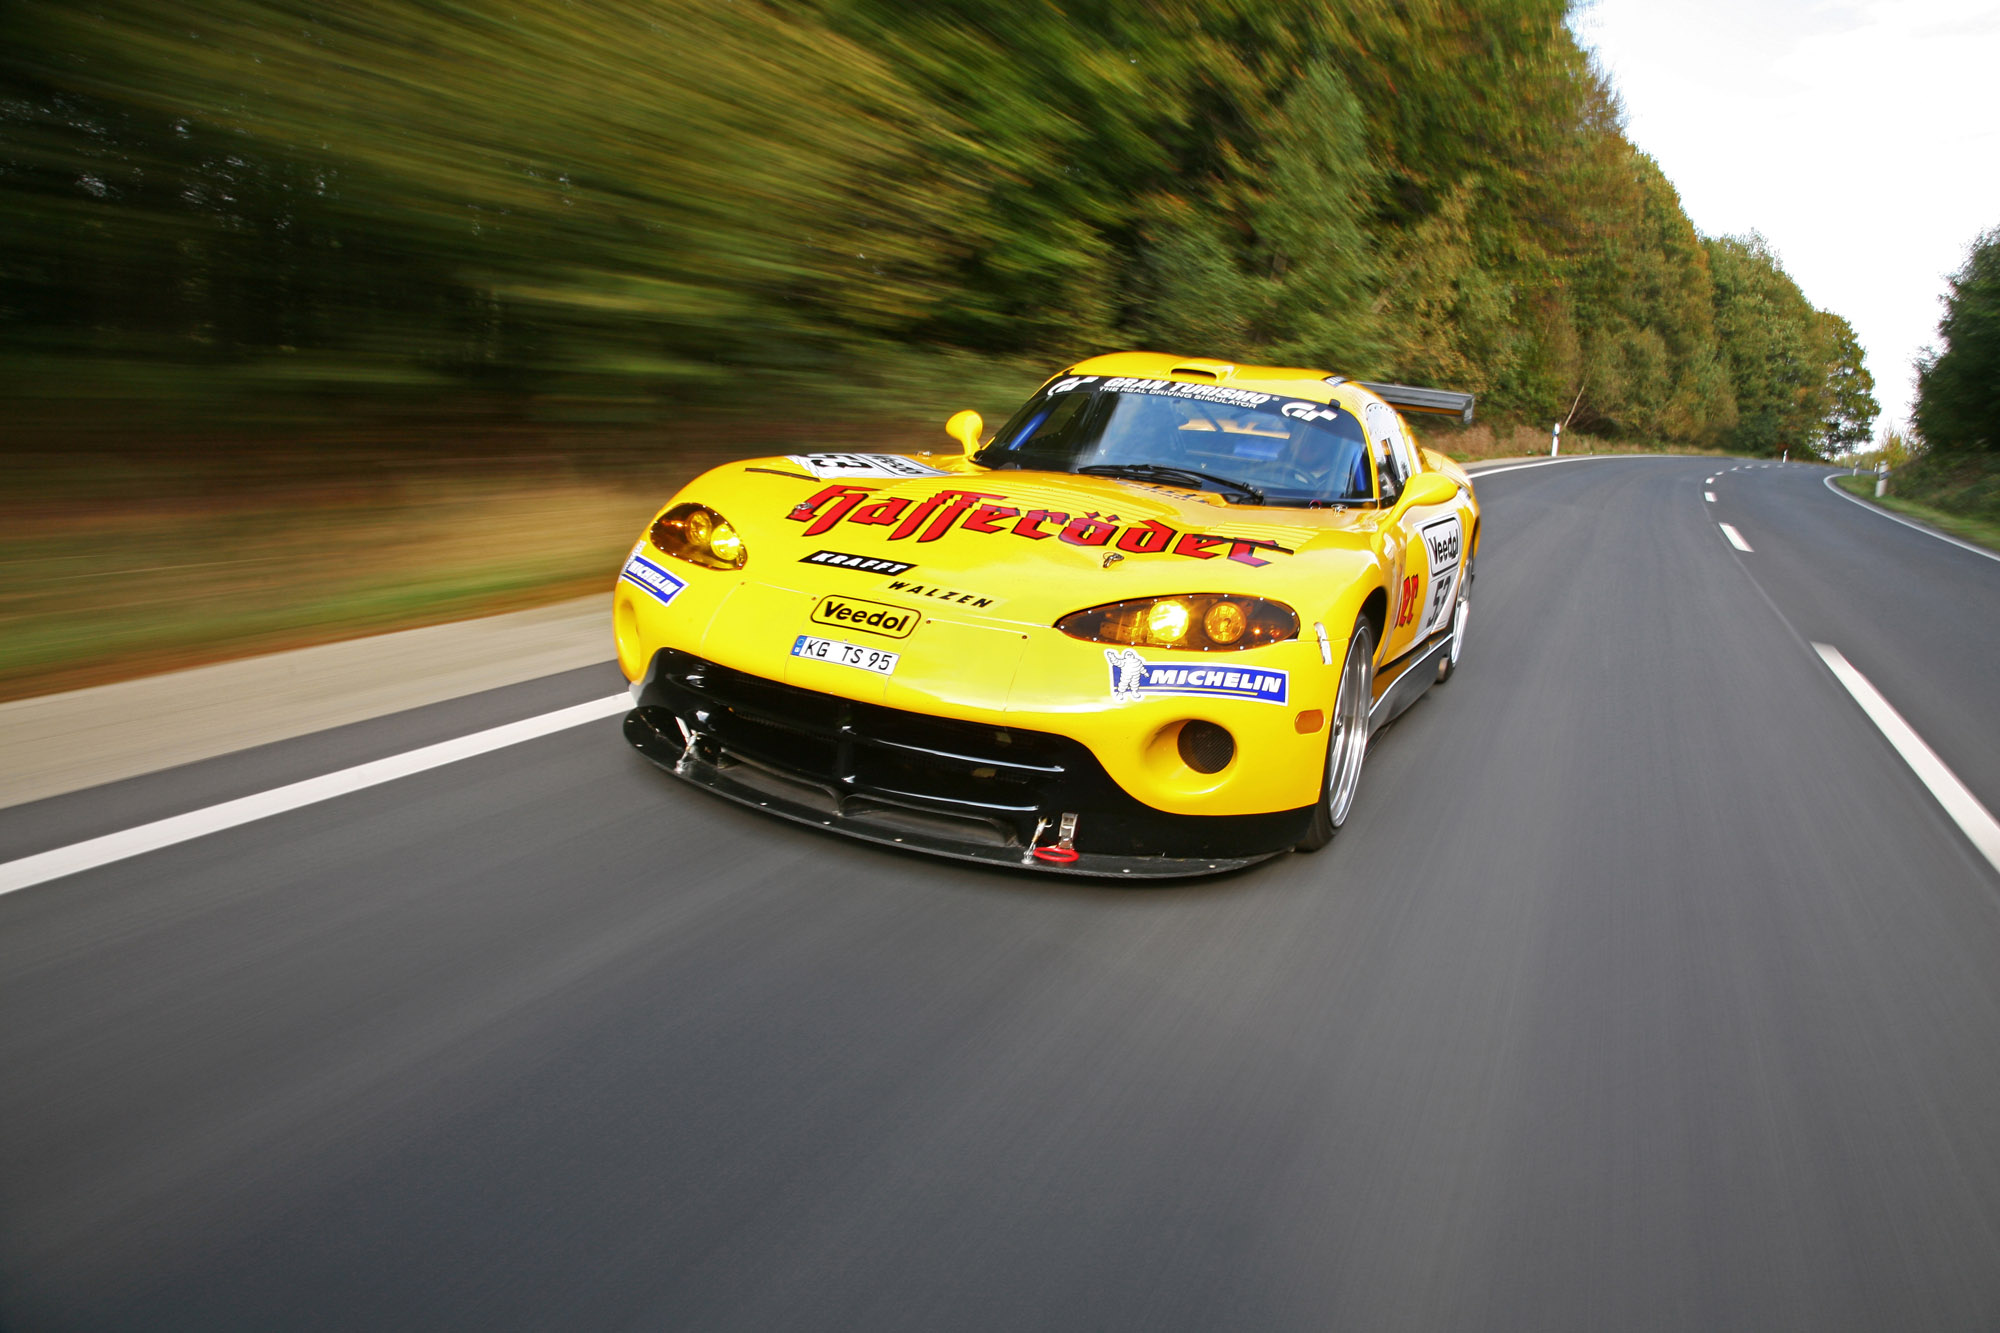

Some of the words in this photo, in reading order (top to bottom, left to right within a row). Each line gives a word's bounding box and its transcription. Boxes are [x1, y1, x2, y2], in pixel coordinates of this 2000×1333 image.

[1104, 377, 1171, 391] GRAN
[1170, 382, 1271, 405] TURISMO
[1148, 389, 1191, 399] DRIVING
[1194, 394, 1257, 409] SIMULATOR
[1428, 529, 1459, 565] Veedol
[811, 552, 909, 574] KRAFFT
[627, 560, 681, 596] MICHELIN
[888, 581, 994, 609] WALZEN
[823, 600, 910, 632] Veedol
[804, 639, 830, 658] KG
[842, 646, 863, 664] TS
[867, 652, 892, 671] 95
[1150, 669, 1282, 694] MICHELIN
